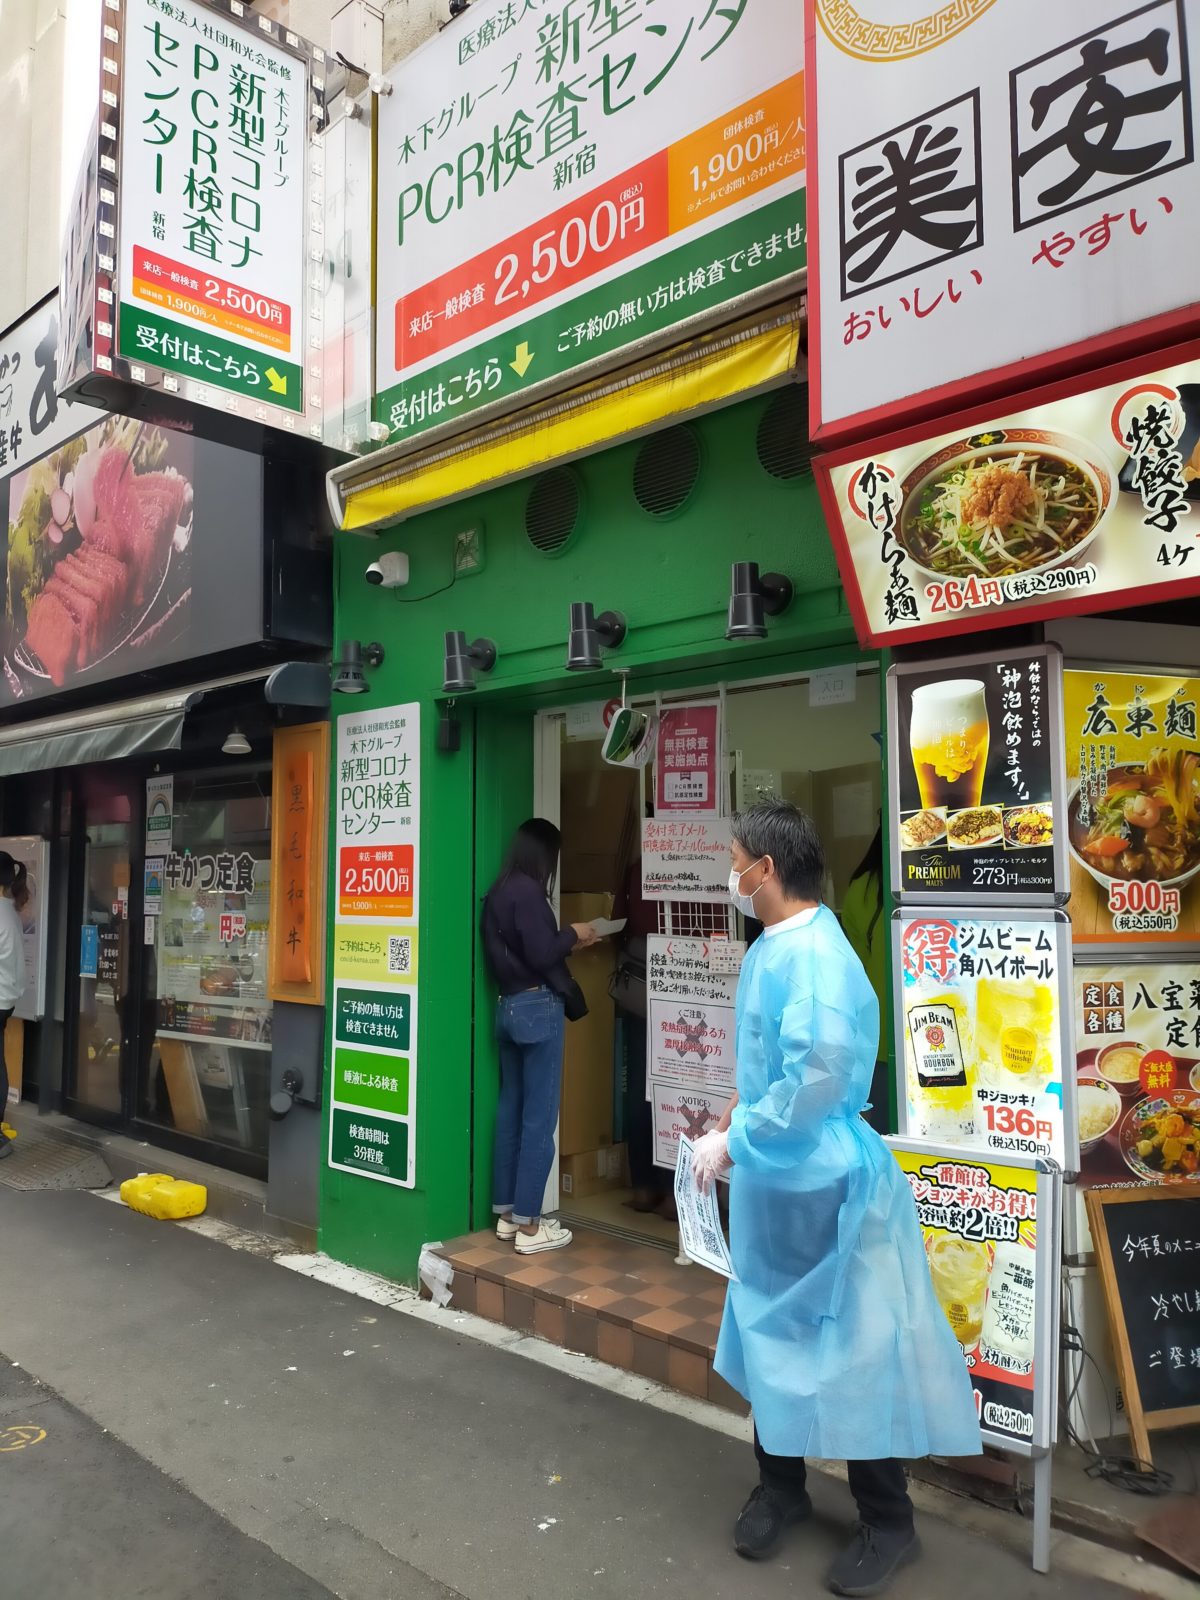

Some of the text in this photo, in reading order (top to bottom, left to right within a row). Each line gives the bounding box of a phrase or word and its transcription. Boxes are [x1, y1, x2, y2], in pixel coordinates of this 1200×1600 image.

[458, 0, 550, 66] 医療法人
[143, 20, 180, 194] センター
[397, 52, 522, 166] 木下グループ
[1018, 27, 1184, 208] 安
[274, 88, 290, 187] 木下グループ
[723, 108, 766, 141] 団体検査
[182, 44, 224, 264] PCR検査
[228, 63, 267, 268] 新型コロナ
[552, 143, 597, 192] 新宿
[845, 124, 977, 283] 美
[152, 210, 166, 242] 新宿
[1031, 196, 1174, 269] やすい
[408, 282, 486, 337] 来店一般検査
[494, 195, 645, 306] 2,500円
[142, 260, 283, 325] 来店一般検査 2,500円
[556, 222, 808, 353] ご予約の無い方は検査できませ
[843, 269, 983, 346] おいしい
[136, 324, 261, 386] 受付はこちら
[389, 357, 503, 435] 受付はこちら
[1126, 402, 1189, 533] 焼餃子
[858, 461, 921, 626] かけらぁ麺
[926, 564, 1098, 614] 264円 (税込290円)
[1028, 661, 1042, 748] 外飲みならではの
[1082, 694, 1197, 740] 広東麺
[350, 733, 403, 755] 木下グループ
[663, 736, 709, 752] 無料検査
[341, 752, 412, 783] 新型コロナ
[663, 752, 709, 768] 実施拠点
[341, 780, 412, 811] PCR検査
[341, 812, 396, 835] センター
[358, 851, 394, 862] 来店一般検査
[164, 852, 257, 894] 牛かつ定食
[345, 867, 409, 896] 2,500円
[908, 865, 961, 880] PREMIUM
[972, 867, 1019, 886] 273円
[1109, 881, 1179, 912] 500円
[1114, 915, 1177, 931] (税込550円)
[339, 940, 382, 954] ご予約はこちら
[912, 927, 956, 976] 得
[959, 926, 1052, 952] ジムビーム
[959, 953, 1054, 979] 角ハイボール
[342, 999, 404, 1020] ご予約の無い方は
[1085, 985, 1121, 1006] 定食
[345, 1018, 399, 1040] 検査できません
[913, 1011, 954, 1033] JIM BEAM
[1086, 1010, 1122, 1032] 各種
[924, 1058, 956, 1068] BOURBON
[1143, 1061, 1174, 1073] ご飯大盛
[343, 1069, 399, 1093] 唾液による検査
[1147, 1073, 1171, 1089] 無料
[661, 1103, 676, 1113] With
[977, 1088, 1036, 1108] 中ジョッキ!
[348, 1122, 390, 1146] 検査時間は
[983, 1104, 1053, 1142] 136円
[353, 1144, 385, 1166] 3分程度
[987, 1135, 1052, 1156] (税込150円)
[922, 1165, 987, 1189] 一番館は
[909, 1178, 1037, 1217] ジョッキがお得!
[1004, 1271, 1035, 1290] 一番館
[986, 1405, 1033, 1430] (税込250円)
